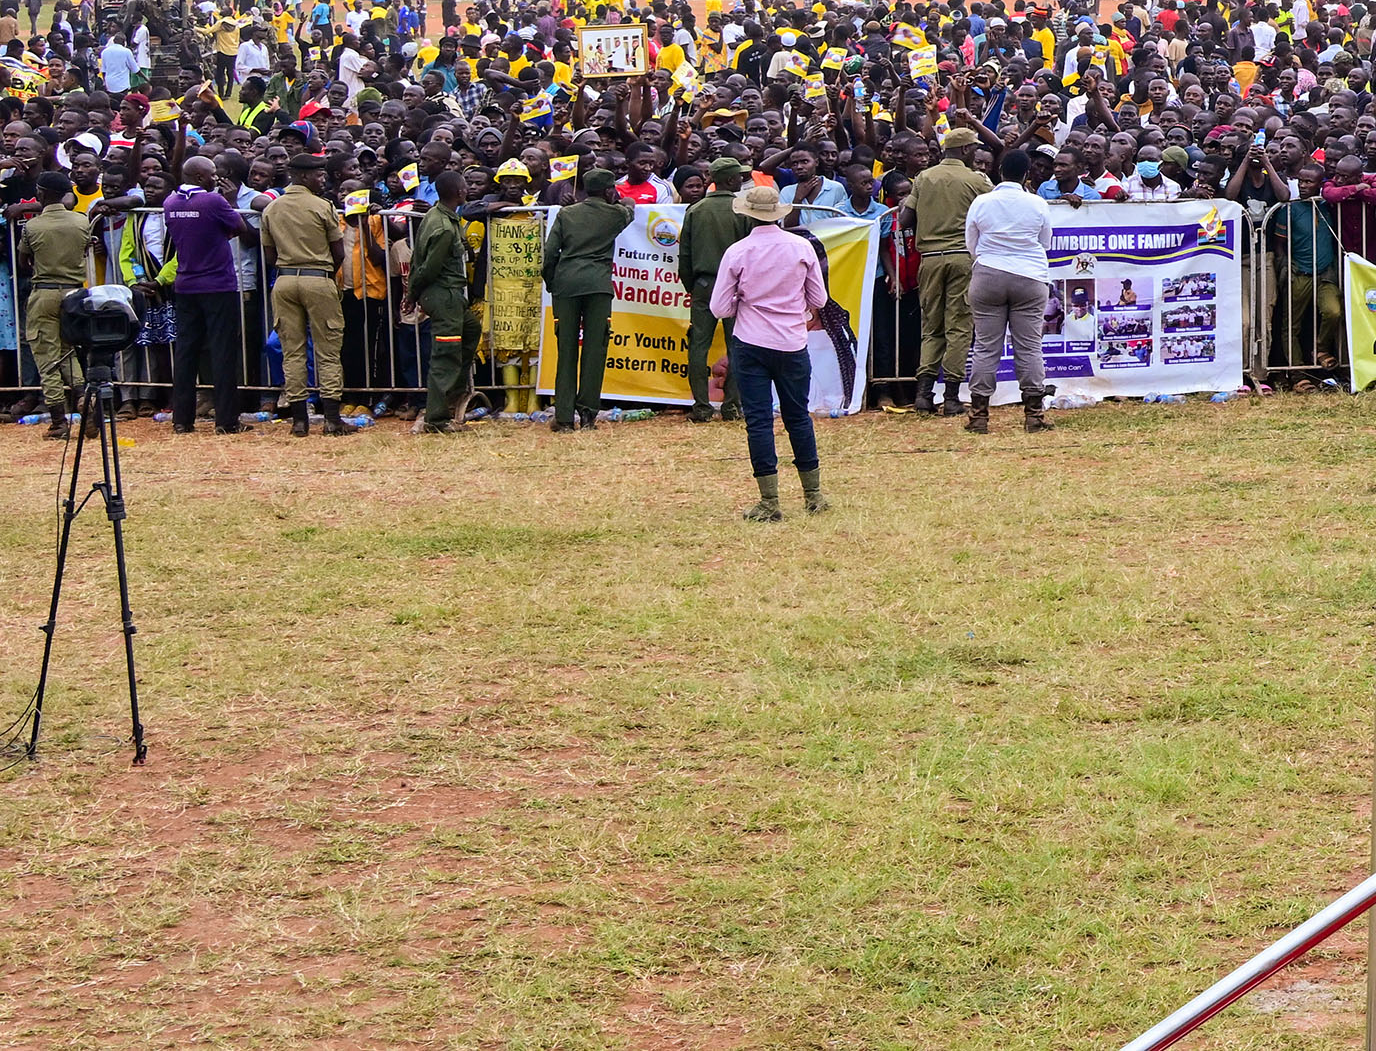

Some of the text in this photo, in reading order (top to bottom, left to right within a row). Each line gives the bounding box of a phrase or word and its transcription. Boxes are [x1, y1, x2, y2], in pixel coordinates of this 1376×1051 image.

[1051, 232, 1185, 250] IMBUDE ONE FAMILY
[618, 247, 674, 264] Future is
[612, 262, 680, 284] Auma Kev
[635, 332, 676, 351] Youth
[606, 356, 656, 372] astern
